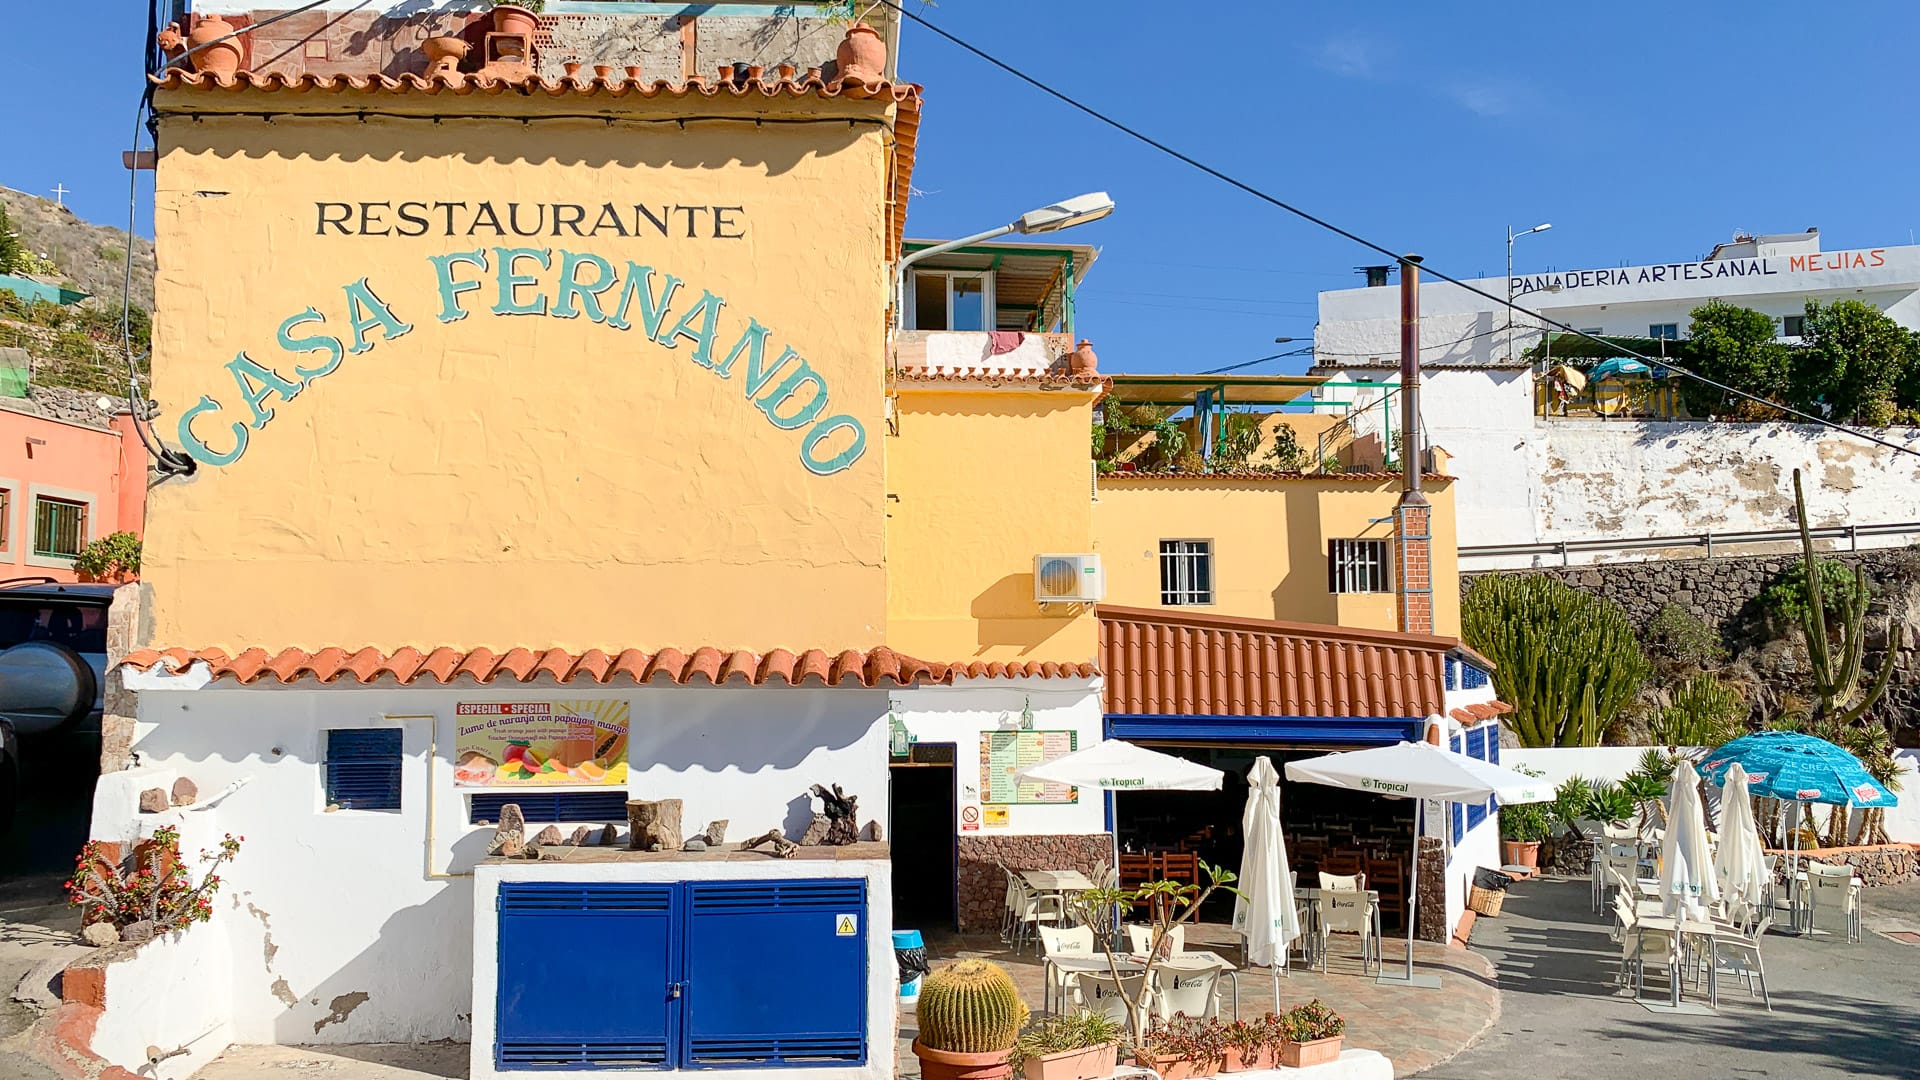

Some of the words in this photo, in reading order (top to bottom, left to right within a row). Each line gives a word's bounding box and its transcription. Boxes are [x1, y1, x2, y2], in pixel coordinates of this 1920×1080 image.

[314, 201, 747, 239] RESTAURANTE
[1511, 269, 1630, 294] PANADERIA
[1637, 258, 1778, 284] ARTESANAL
[1790, 249, 1886, 273] MEJIAS
[177, 277, 416, 468] CASA
[427, 246, 868, 478] FERNANDO
[459, 704, 503, 715] ESPECIAL
[511, 703, 549, 714] SPECIAL
[458, 722, 485, 737] Zumo
[486, 719, 498, 729] de
[499, 714, 535, 726] naranja
[537, 714, 552, 723] con
[554, 714, 588, 727] papaya
[597, 720, 628, 735] mango
[1110, 777, 1145, 788] Tropical
[1373, 779, 1409, 793] Tropical
